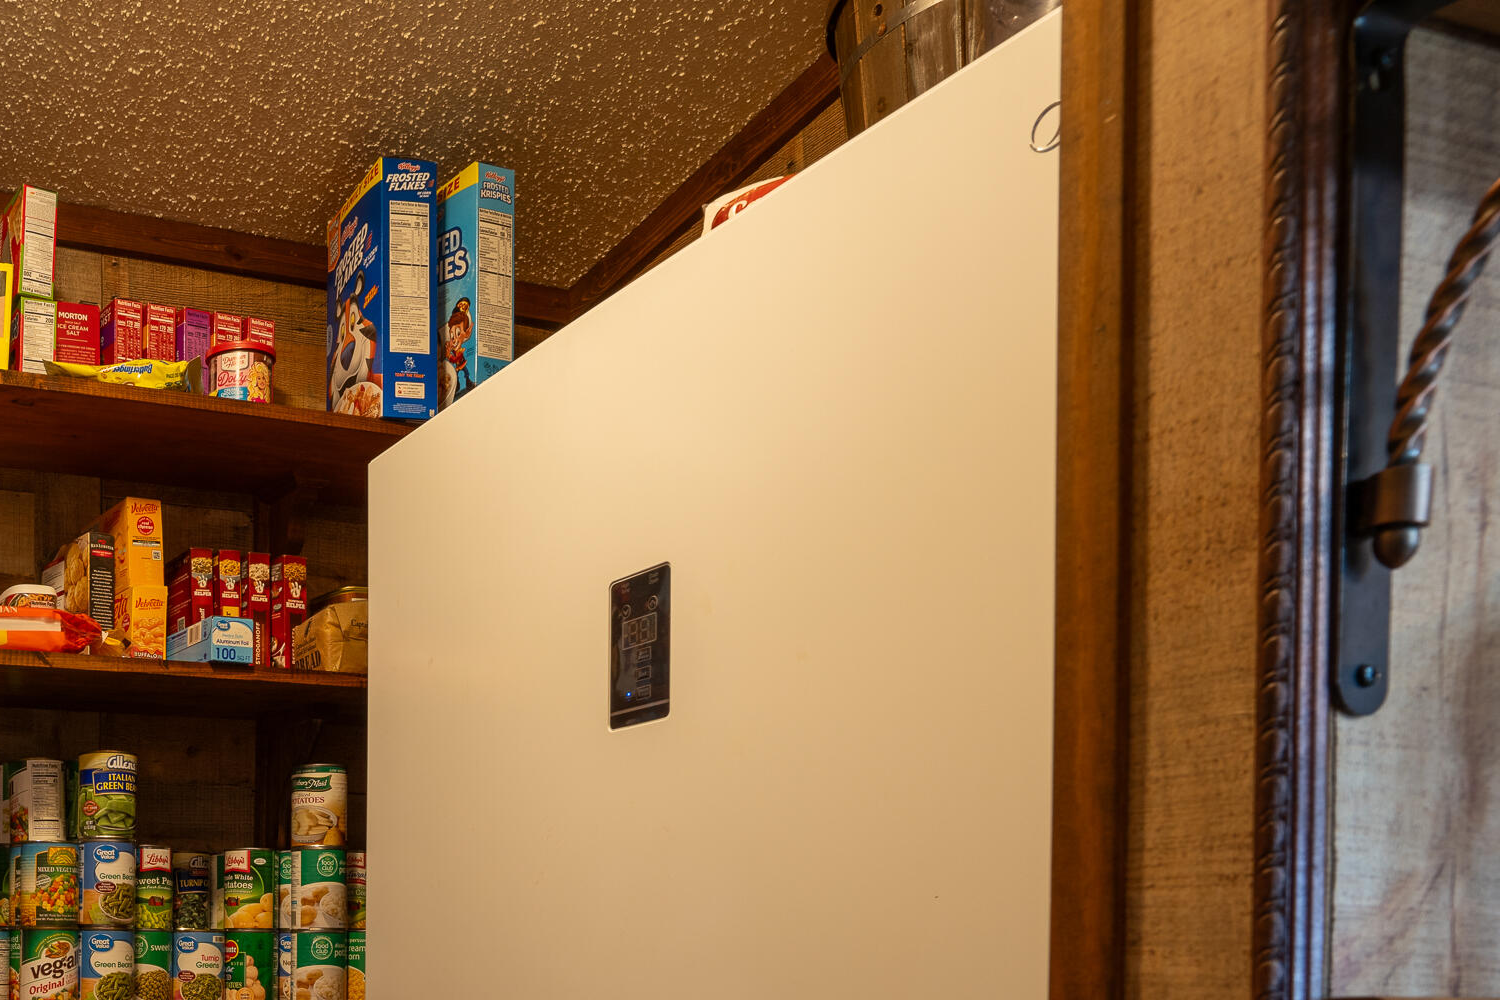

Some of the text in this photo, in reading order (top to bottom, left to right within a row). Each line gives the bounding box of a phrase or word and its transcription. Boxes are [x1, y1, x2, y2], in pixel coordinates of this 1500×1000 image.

[363, 163, 380, 189] SIZE
[386, 172, 430, 183] FROSTED
[388, 181, 426, 191] FLAKES
[483, 181, 509, 193] FROSTED
[480, 189, 511, 204] KRISPIES
[58, 312, 88, 321] MORTON
[68, 324, 89, 332] CREAM
[112, 364, 153, 374] Butterfinger
[131, 502, 160, 514] Velveeta
[136, 598, 164, 609] Velveeta
[134, 652, 160, 664] BUFFALO
[215, 647, 236, 661] 100
[108, 773, 136, 783] ITALIAN
[96, 782, 124, 792] GREEN
[96, 848, 116, 856] Great
[146, 853, 169, 865] Libby's
[226, 856, 245, 867] Libby's
[91, 938, 110, 946] Great
[316, 942, 328, 950] food
[316, 948, 328, 956] club
[201, 954, 220, 962] Turnip
[196, 961, 220, 969] Greens
[29, 976, 65, 995] Original
